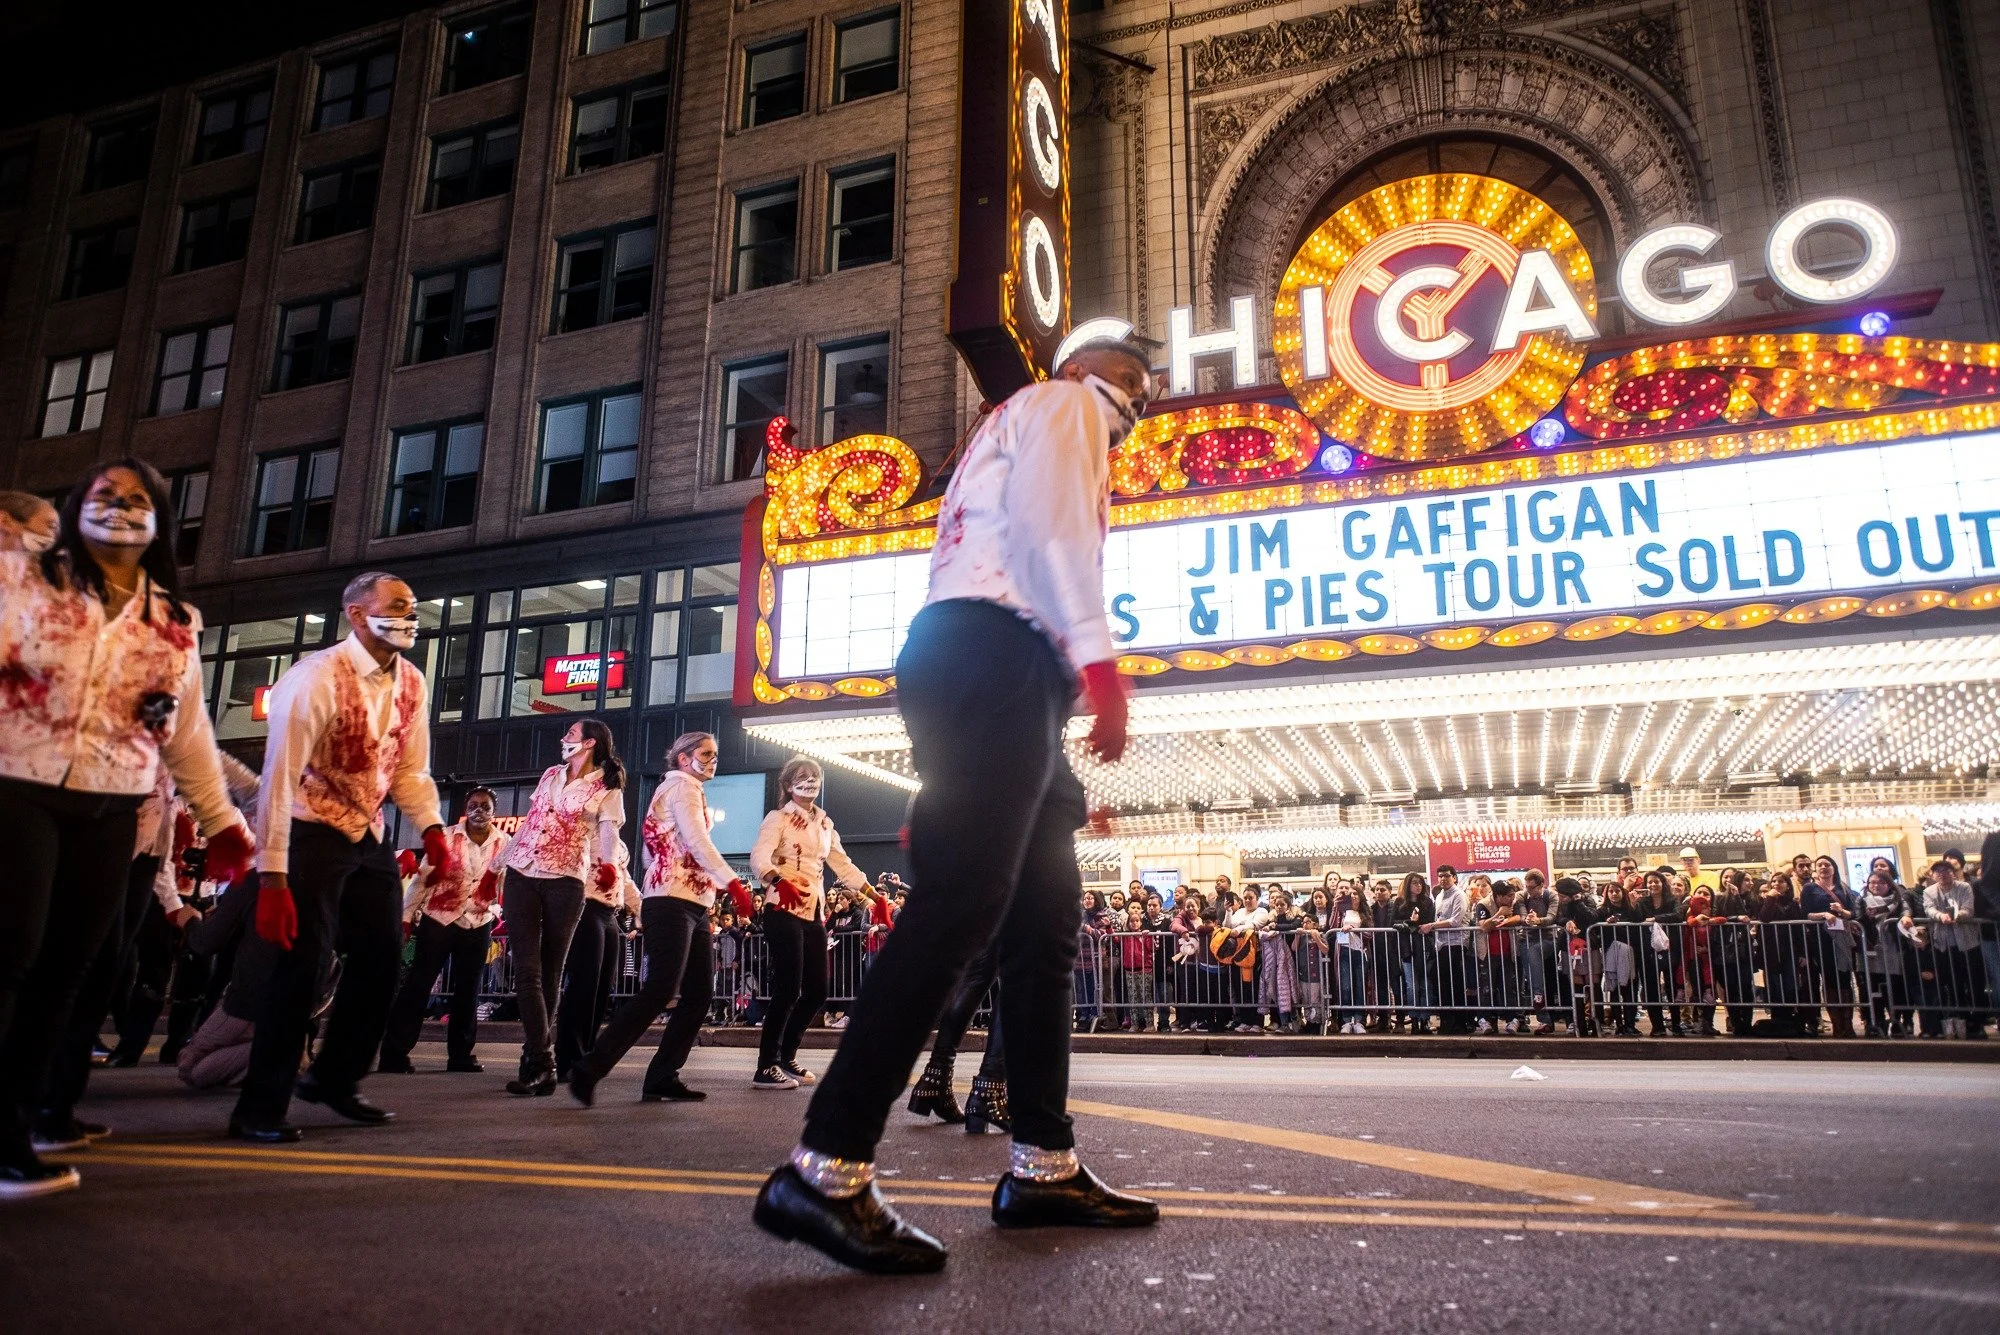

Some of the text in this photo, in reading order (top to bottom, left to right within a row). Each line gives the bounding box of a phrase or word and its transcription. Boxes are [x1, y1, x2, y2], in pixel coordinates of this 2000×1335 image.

[1187, 479, 1660, 577] JIM GAFFIGAN
[1189, 585, 1219, 635] &
[1265, 572, 1389, 629] PIES
[1423, 551, 1590, 616] TOUR
[1636, 530, 1805, 598] SOLD
[1856, 510, 2000, 577] OUT
[555, 658, 615, 673] MATTRE
[567, 670, 599, 683] FIRM
[1474, 845, 1510, 853] CHICAGO
[1078, 861, 1105, 872] ASE
[1480, 910, 1486, 919] 2
